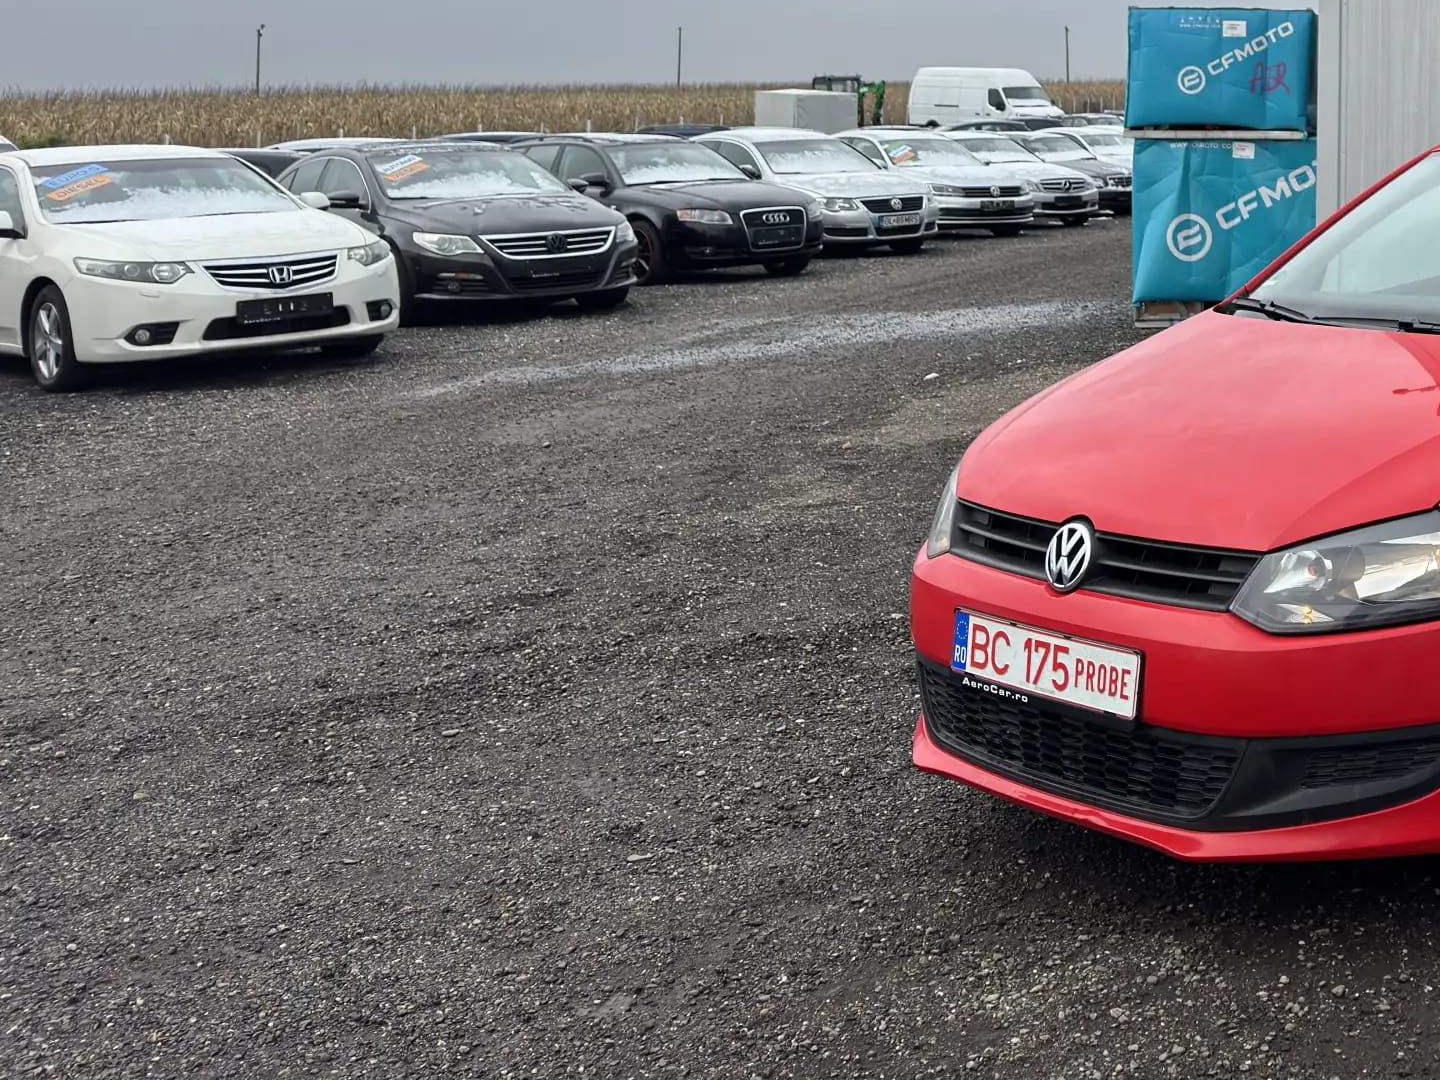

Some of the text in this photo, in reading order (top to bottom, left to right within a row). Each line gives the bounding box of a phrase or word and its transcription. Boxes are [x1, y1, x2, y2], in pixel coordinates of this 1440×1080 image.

[1207, 21, 1294, 76] CFMOTO
[1215, 160, 1318, 230] CFMO
[954, 644, 967, 664] RO
[970, 623, 1131, 701] BC 175 PROBE
[962, 676, 1029, 703] AeroCar.ro
